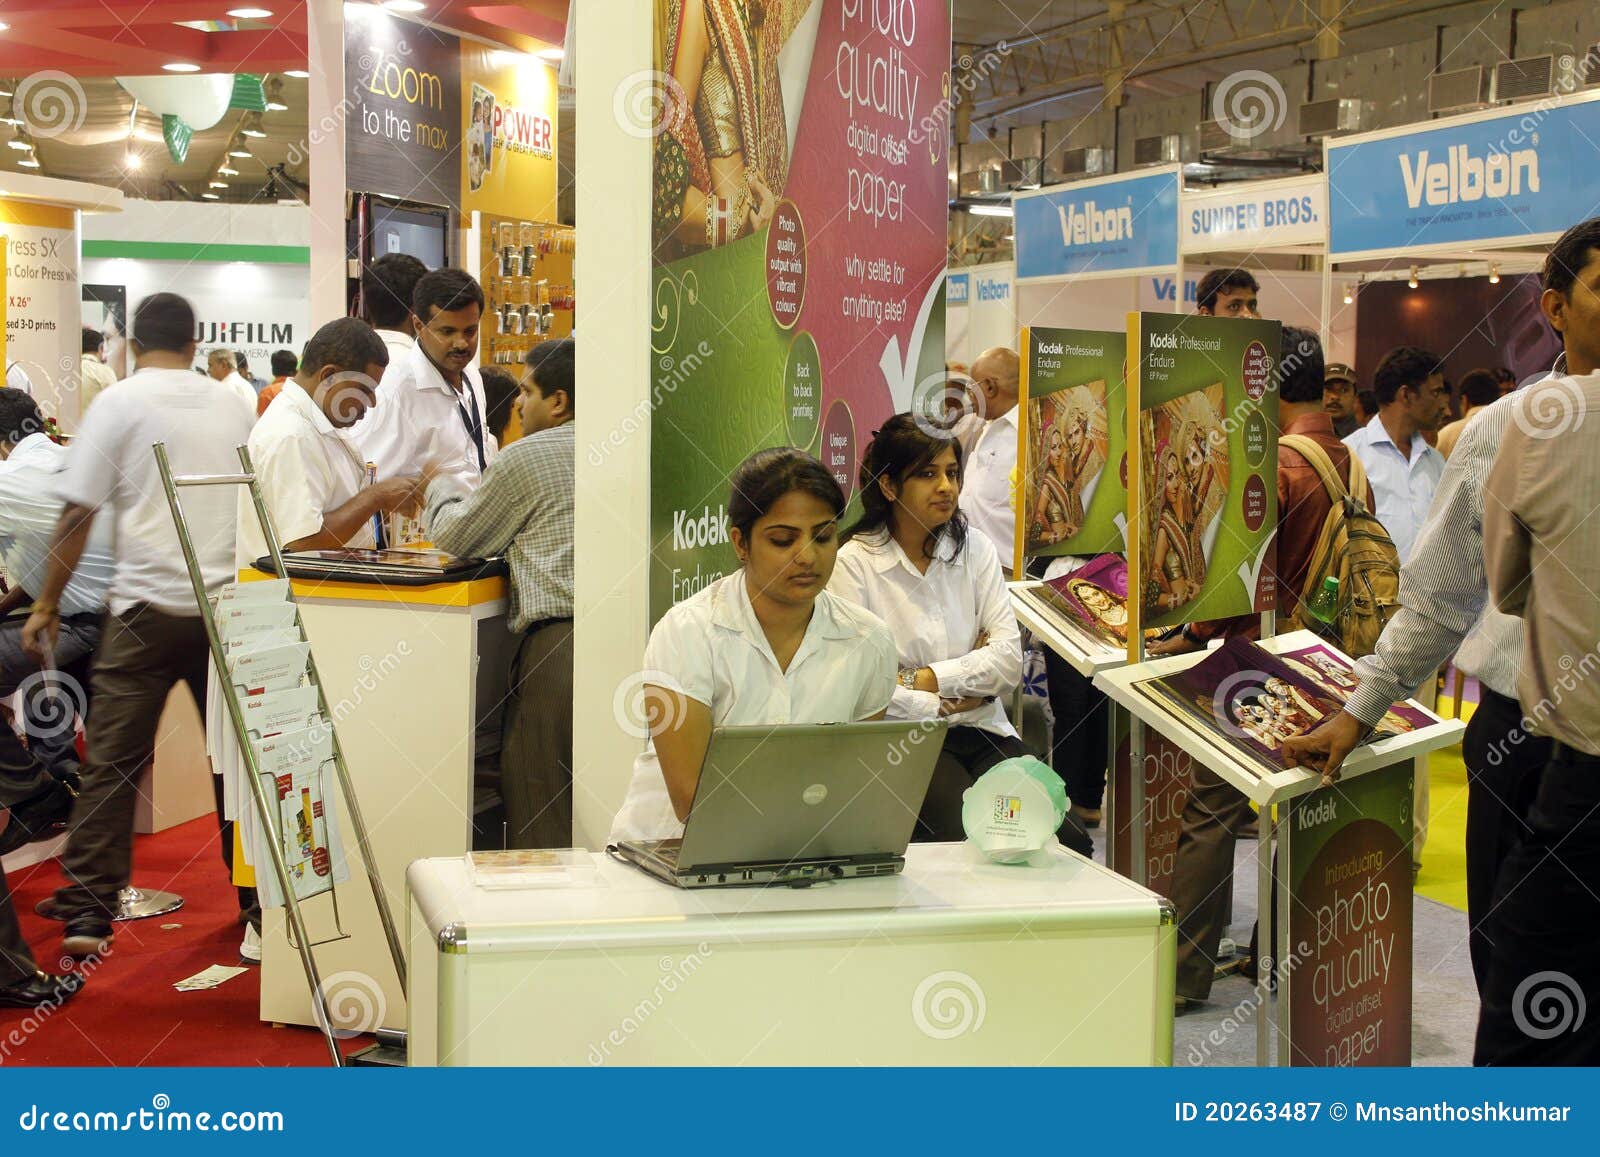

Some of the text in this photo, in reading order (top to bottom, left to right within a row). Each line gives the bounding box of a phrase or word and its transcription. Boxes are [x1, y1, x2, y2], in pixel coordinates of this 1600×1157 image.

[369, 46, 442, 110] Zoom
[836, 41, 919, 139] quality
[363, 103, 449, 151] to the max
[493, 105, 551, 150] POWER
[847, 120, 909, 166] digital offset
[1397, 142, 1541, 209] Velbon
[848, 167, 905, 228] paper
[778, 215, 796, 233] Photo
[1057, 201, 1133, 246] Velbon
[1191, 196, 1318, 234] SUNDER BROS.
[40, 236, 58, 258] SX
[776, 238, 797, 256] quality
[14, 264, 39, 279] Color
[41, 265, 65, 281] Press
[770, 258, 802, 275] output with
[845, 253, 905, 286] why settle for
[776, 278, 797, 294] vibrant
[976, 278, 1009, 301] Velbon
[775, 300, 797, 314] colours
[842, 294, 907, 325] anything else?
[6, 319, 57, 331] sed 3-D prints
[1038, 342, 1104, 357] Kodak Professional
[1149, 333, 1221, 351] Kodak Professional
[797, 363, 809, 378] Back
[1037, 357, 1062, 369] Endura
[1149, 353, 1176, 369] Endura
[793, 383, 812, 397] to back
[792, 403, 813, 420] printing
[830, 433, 847, 449] Unique
[834, 471, 847, 484] rface
[673, 504, 729, 551] Kodak
[1299, 797, 1337, 830] Kodak
[1325, 850, 1383, 886] Introducing
[1316, 876, 1390, 960] photo
[1312, 929, 1395, 1013] quality
[1326, 988, 1382, 1033] digital offset
[1326, 1019, 1383, 1067] paper
